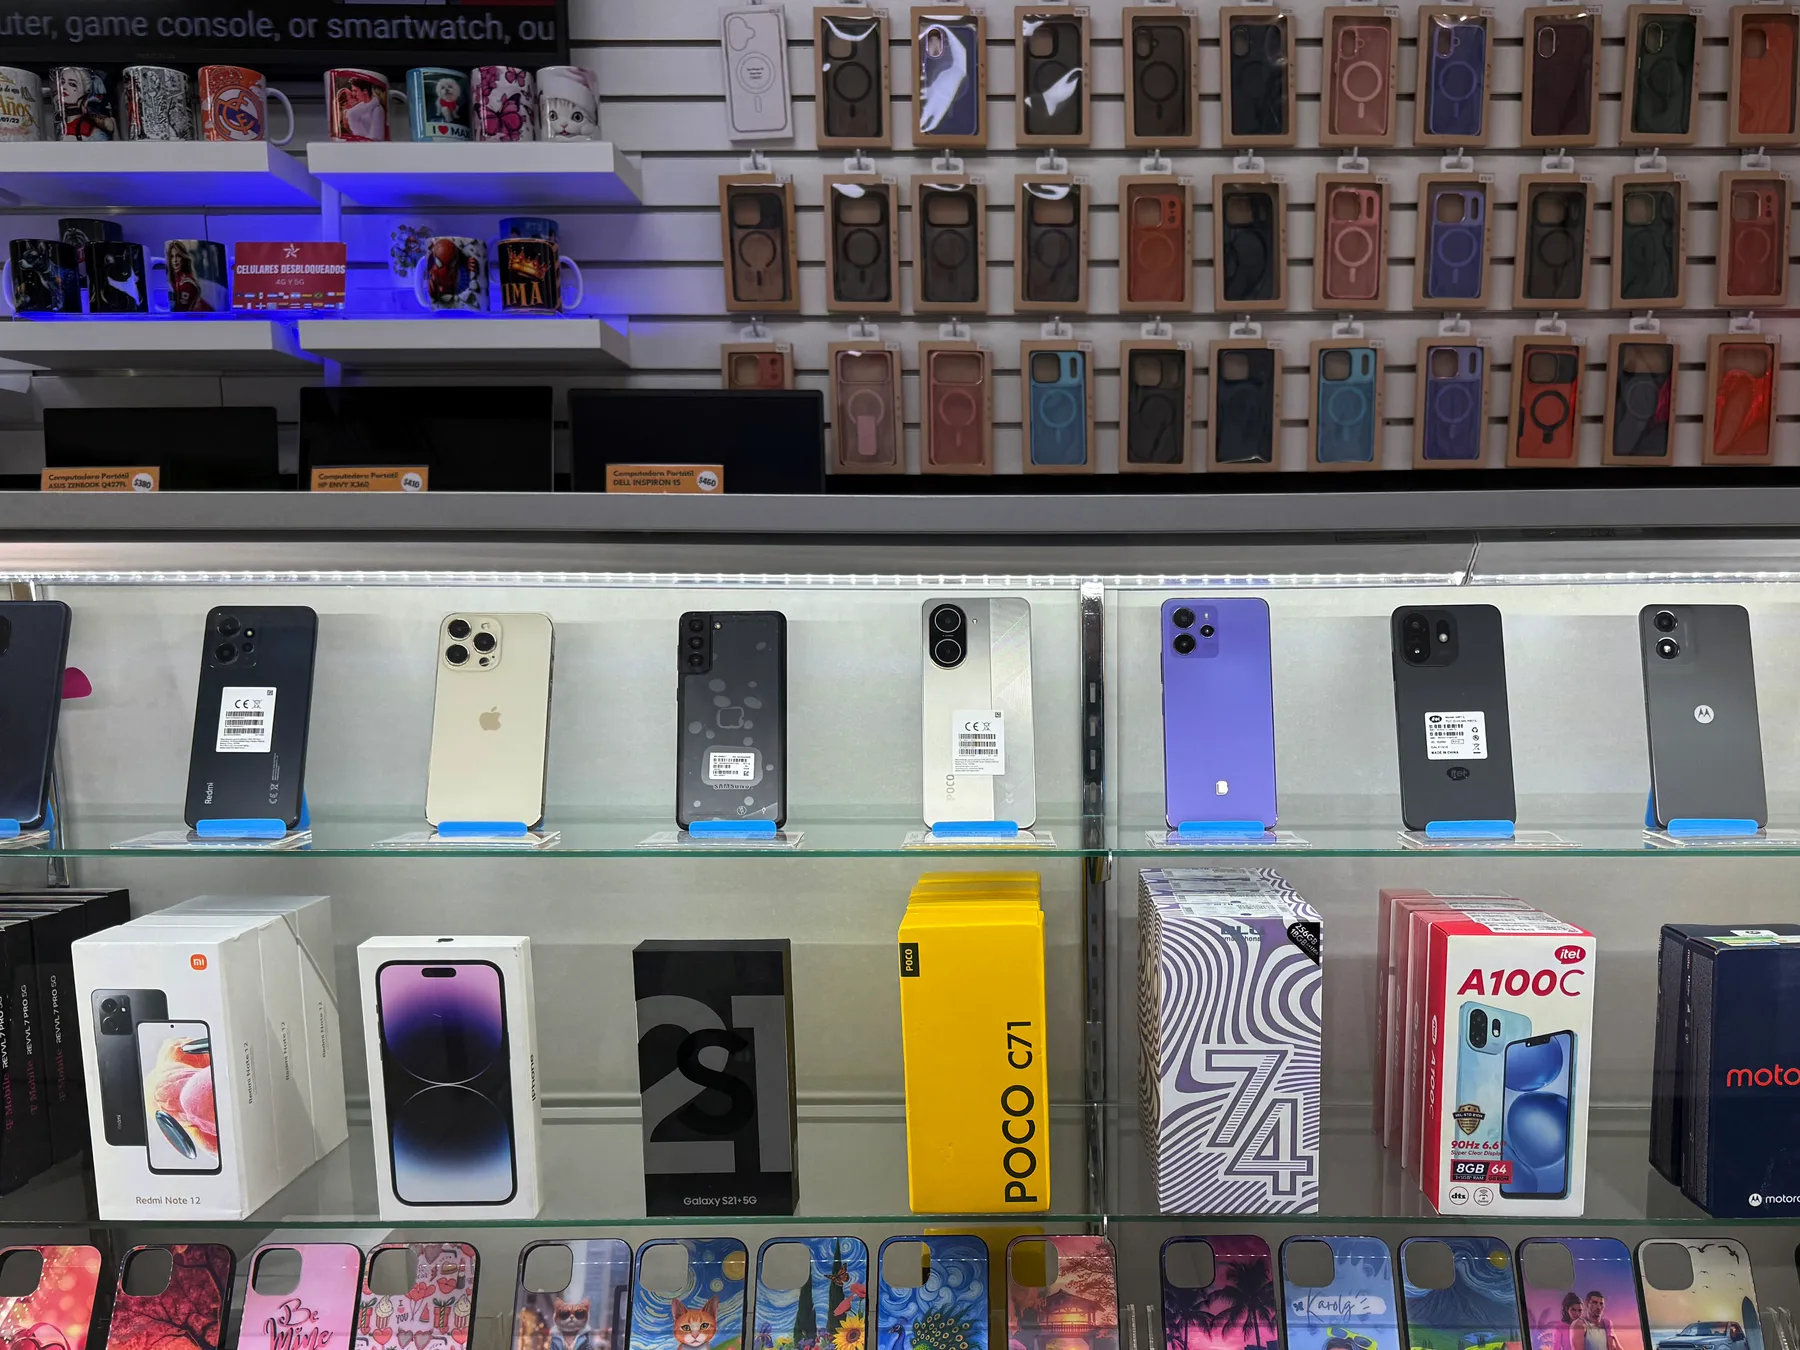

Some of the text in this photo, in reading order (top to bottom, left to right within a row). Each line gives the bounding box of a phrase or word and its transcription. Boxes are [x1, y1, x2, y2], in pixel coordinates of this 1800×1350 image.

[66, 16, 148, 42] game
[157, 10, 280, 42] console,
[289, 18, 318, 38] or
[327, 13, 510, 44] smartwatch,
[518, 20, 555, 40] ou
[236, 264, 346, 274] CELULARES DESBLOQUEADOS
[204, 782, 214, 804] Redmi
[946, 774, 955, 802] POCO
[1295, 922, 1318, 945] 256GB
[905, 948, 914, 972] POCO
[1560, 948, 1580, 959] itel
[21, 984, 28, 997] 5G
[50, 975, 57, 988] 5G
[1457, 968, 1585, 996] A100C
[318, 1002, 322, 1011] 12
[281, 1022, 285, 1031] 12
[0, 1036, 8, 1068] REVVL
[244, 1042, 249, 1053] 12
[27, 1060, 37, 1102] Mobile
[1727, 1064, 1800, 1087] moto
[4, 1072, 13, 1116] Mobile
[1001, 1021, 1038, 1202] POCO C71
[1205, 1050, 1314, 1195] 74
[1451, 1140, 1480, 1150] 90Hz
[1456, 1163, 1507, 1174] 8GB 64
[136, 1196, 201, 1205] Redmi Note 12
[683, 1196, 720, 1207] Galaxy
[277, 1298, 319, 1327] Be
[396, 1313, 409, 1324] YOU
[263, 1317, 334, 1350] Mine
